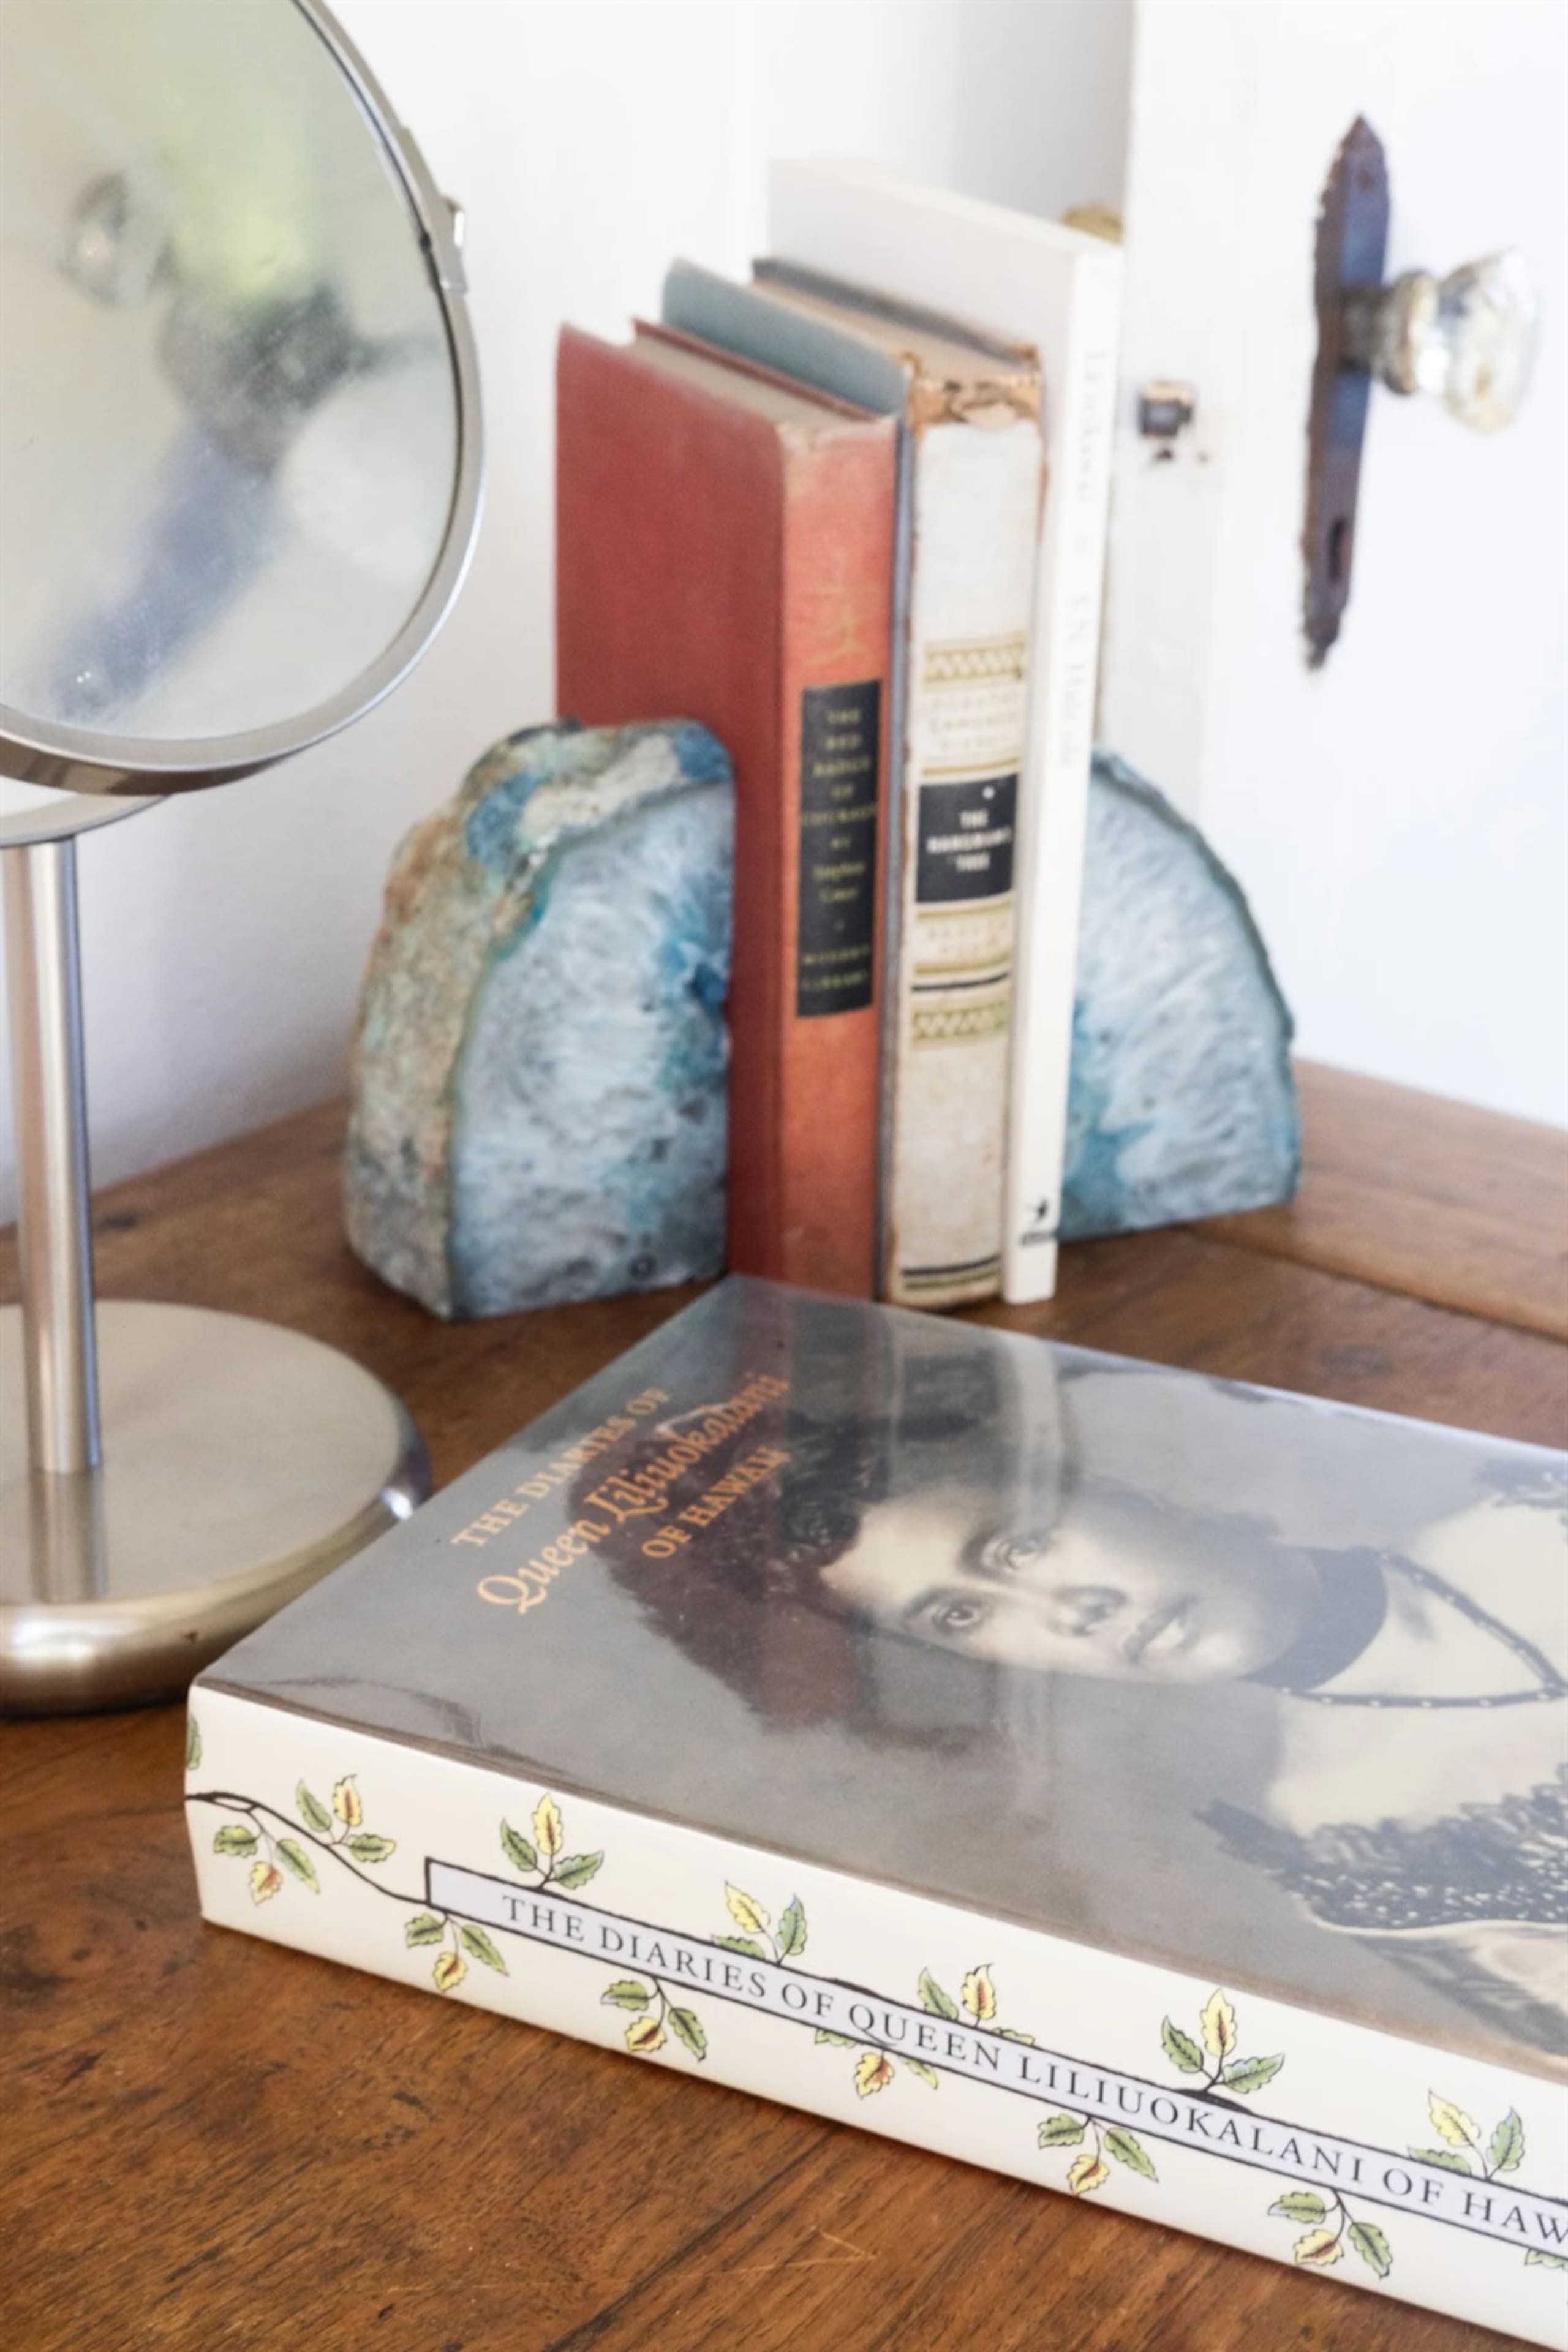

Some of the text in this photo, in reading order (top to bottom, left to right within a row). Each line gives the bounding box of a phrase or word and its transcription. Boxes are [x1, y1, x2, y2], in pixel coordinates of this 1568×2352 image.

[450, 1387, 670, 1547] THE DIARIES OF
[477, 1371, 789, 1615] Queen Liliuokalani
[642, 1525, 693, 1558] OF
[502, 1895, 1568, 2244] THE DIARIES OF QUEEN LILIUOKALANI OF HAW
